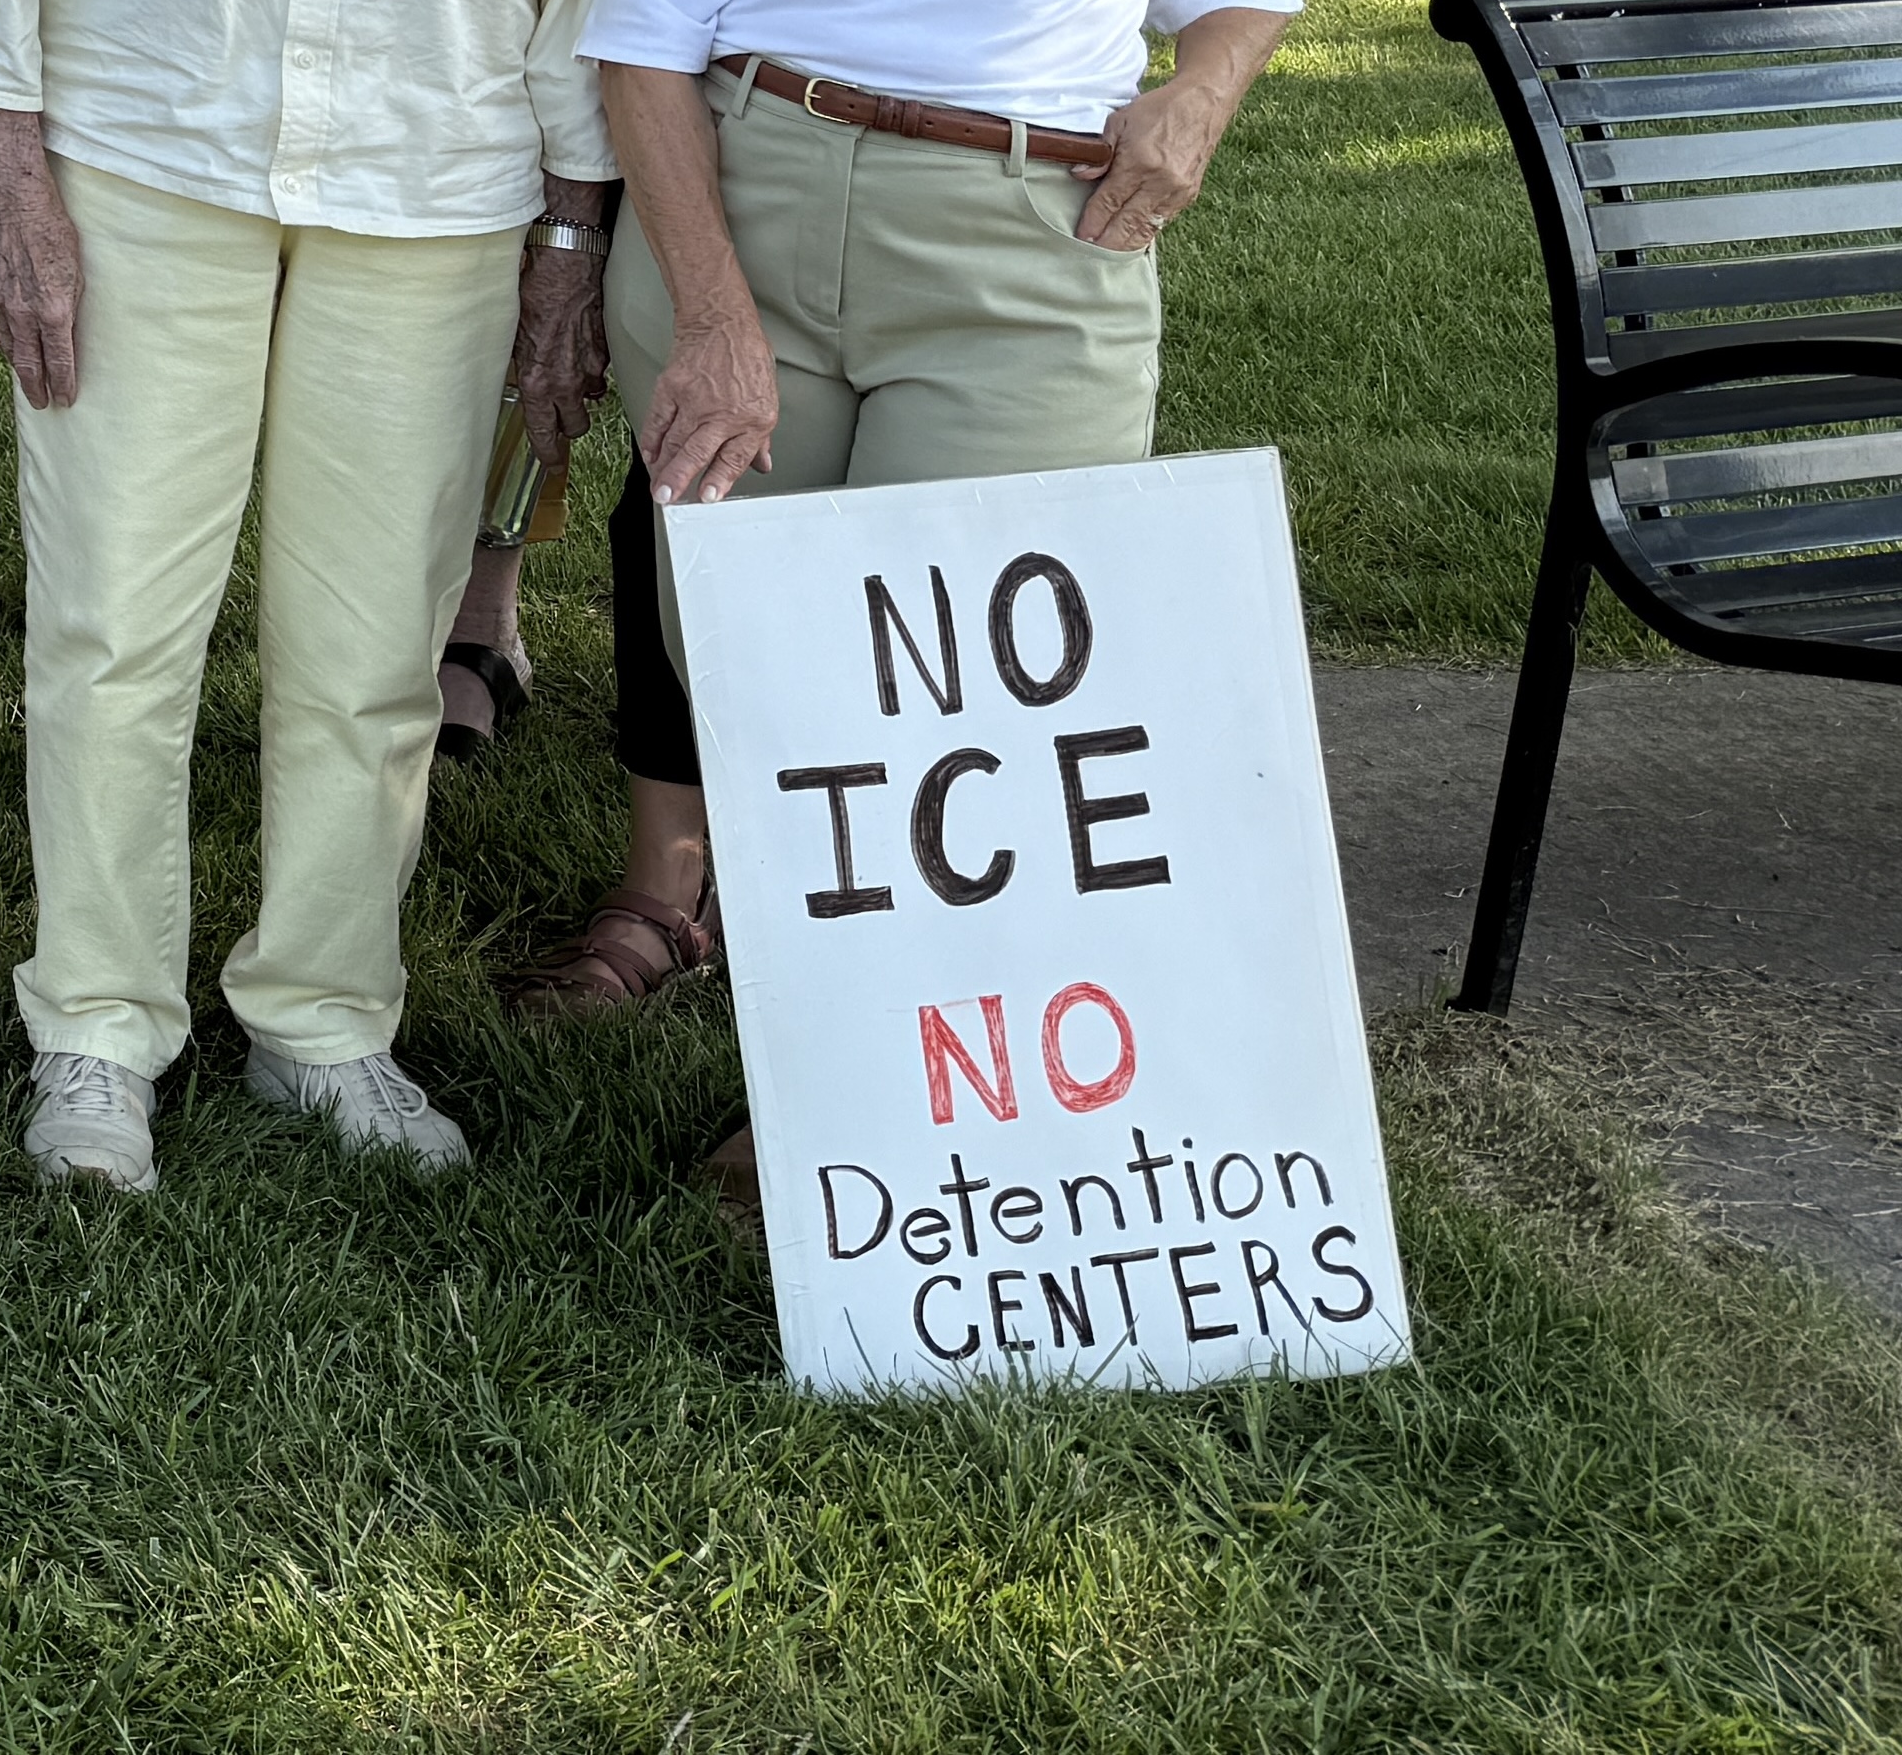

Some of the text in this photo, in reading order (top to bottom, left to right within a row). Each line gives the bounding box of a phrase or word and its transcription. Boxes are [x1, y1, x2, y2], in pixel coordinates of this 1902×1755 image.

[862, 550, 1095, 717] NO
[776, 724, 1172, 920] ICE
[918, 980, 1139, 1125] NO
[817, 1127, 1335, 1265] Detention
[912, 1224, 1376, 1361] CENTERS
